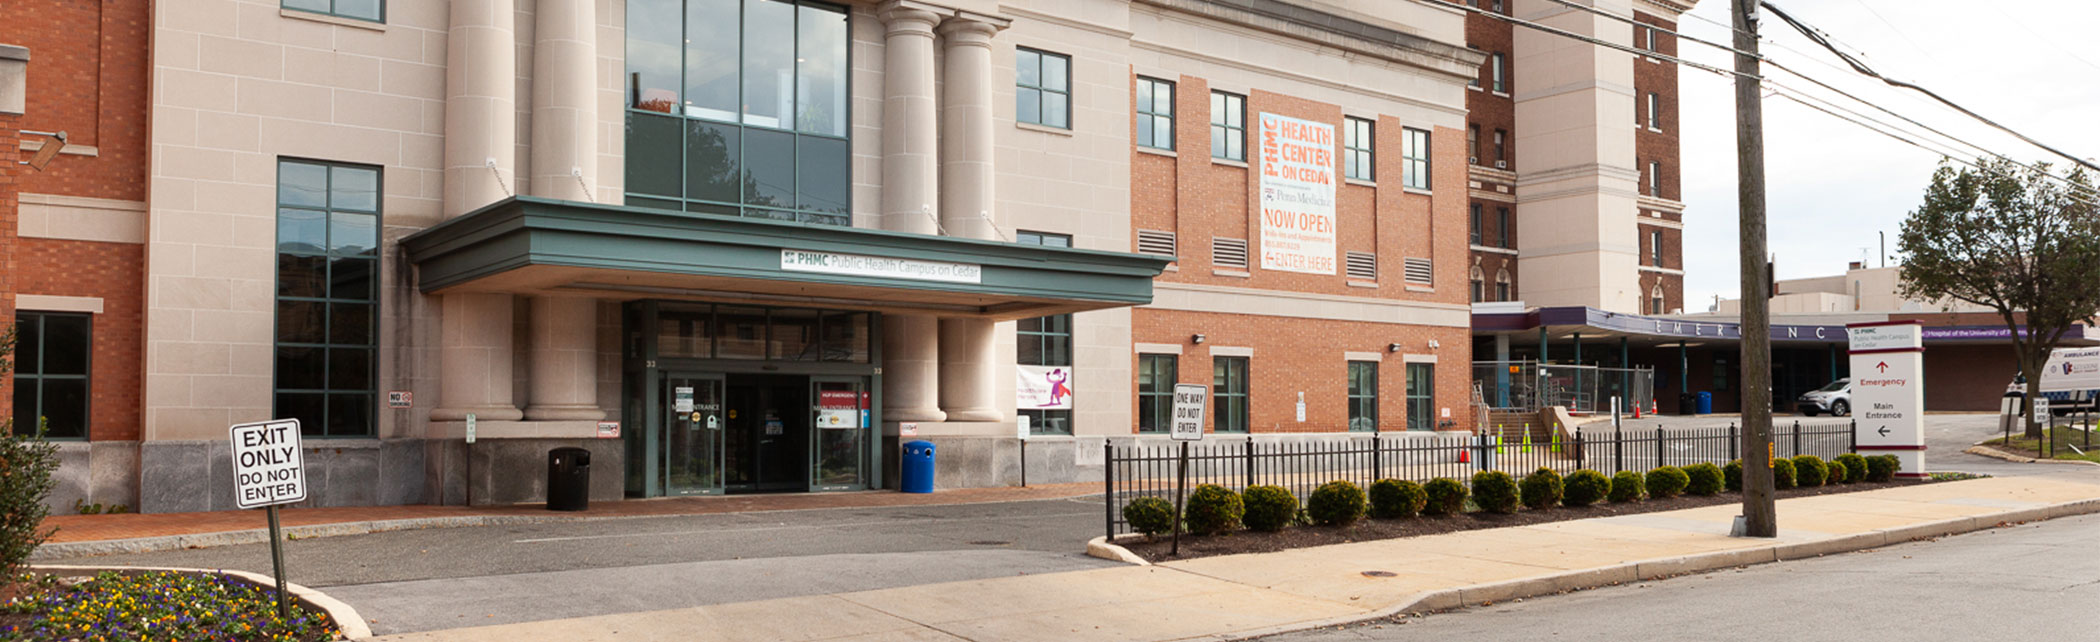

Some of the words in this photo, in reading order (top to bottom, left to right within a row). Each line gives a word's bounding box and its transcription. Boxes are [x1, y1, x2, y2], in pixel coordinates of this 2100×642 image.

[1281, 120, 1331, 146] HEALTH
[1264, 116, 1278, 177] PHMC
[1281, 143, 1331, 168] CENTER
[1282, 165, 1297, 180] ON
[1277, 189, 1297, 202] Penn
[1264, 208, 1296, 229] NOW
[1299, 212, 1333, 234] OPEN
[797, 252, 829, 267] PHMC
[831, 255, 862, 270] Public
[865, 257, 896, 272] Health
[898, 260, 936, 276] Campus
[938, 266, 950, 276] on
[952, 264, 979, 278] Cedar
[1275, 252, 1306, 269] ENTER
[1308, 256, 1333, 271] HERE
[1969, 329, 1998, 337] University
[1860, 379, 1906, 387] Emergency
[390, 393, 401, 401] NO
[1176, 392, 1188, 403] ONE
[1190, 393, 1204, 404] WAY
[1177, 407, 1186, 418] DO
[1187, 407, 1200, 419] NOT
[1177, 422, 1197, 433] ENTER
[243, 427, 288, 447] EXIT
[240, 446, 294, 468] ONLY
[240, 471, 263, 486] DO
[267, 466, 299, 482] NOT
[245, 483, 297, 501] ENTER
